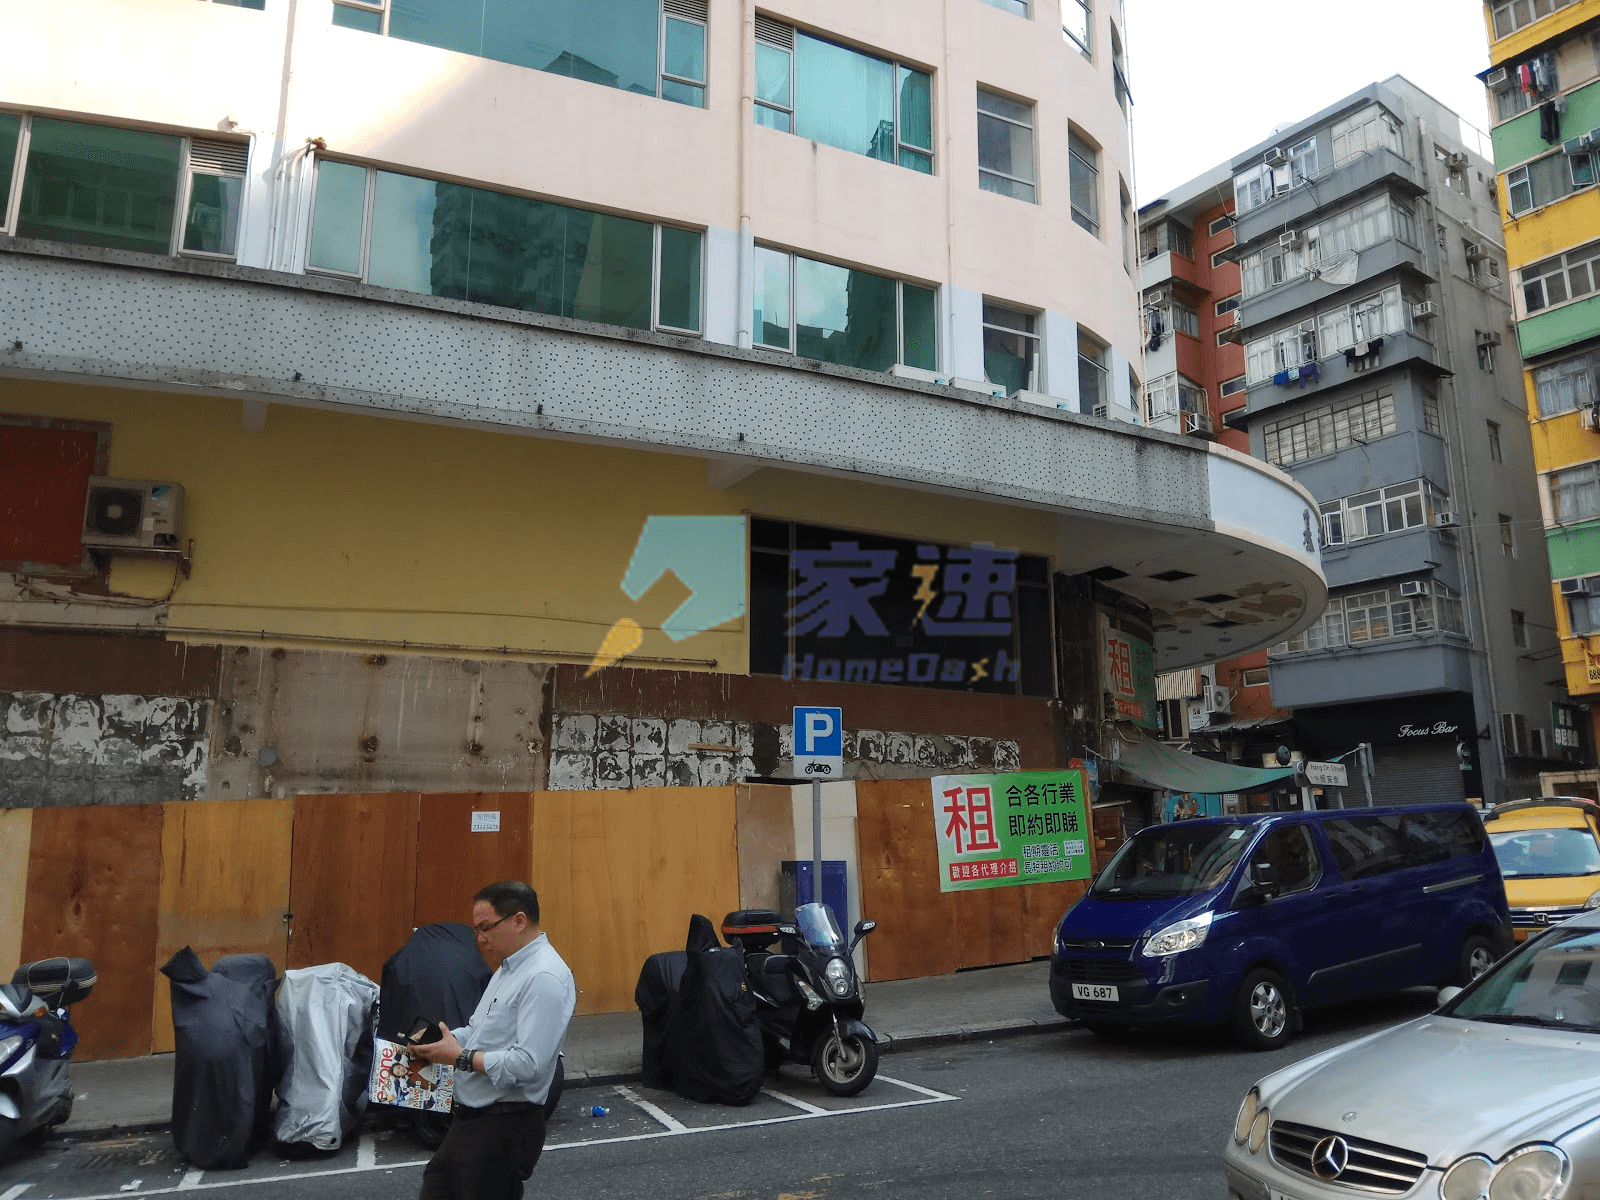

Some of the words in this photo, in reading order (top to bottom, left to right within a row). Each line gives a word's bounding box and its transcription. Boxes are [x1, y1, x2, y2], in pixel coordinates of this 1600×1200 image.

[1107, 639, 1134, 695] 租
[804, 712, 834, 752] P
[1397, 723, 1430, 738] Focus
[1430, 721, 1459, 735] Bar
[1310, 763, 1323, 774] Hang
[1323, 764, 1332, 773] On
[1331, 765, 1345, 773] Street
[1005, 781, 1077, 808] 合各行業
[942, 786, 1000, 855] 租
[1007, 811, 1079, 838] 即約即睇
[1077, 986, 1090, 997] VG
[1093, 987, 1112, 999] 687
[376, 1048, 394, 1101] e-zone
